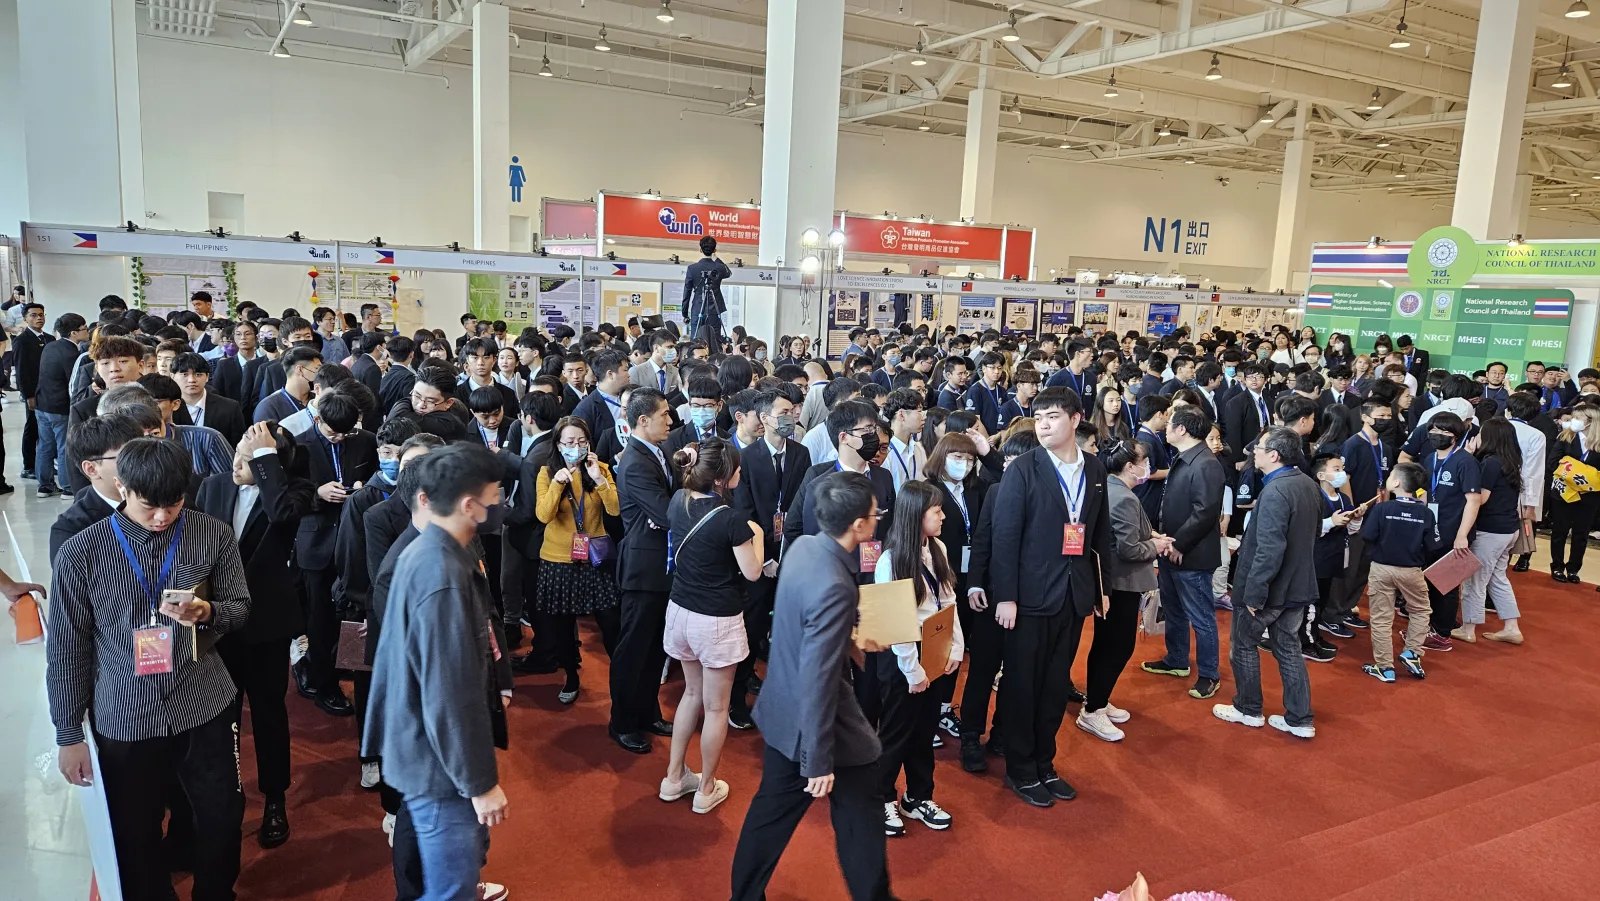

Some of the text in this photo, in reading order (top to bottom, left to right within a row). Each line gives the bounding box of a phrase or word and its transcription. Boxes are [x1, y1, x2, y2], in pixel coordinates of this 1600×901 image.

[708, 210, 739, 223] World
[902, 226, 931, 238] Taiwan
[1187, 220, 1210, 238] 出口
[1143, 216, 1182, 253] N1
[185, 243, 228, 252] PHILIPPINES
[1185, 241, 1208, 255] EXIT
[1486, 249, 1597, 257] NATIONAL RESEARCH
[462, 258, 496, 267] PHILIPPINES
[1485, 260, 1596, 268] COUNCIL OF THAILAND
[1495, 298, 1528, 306] Research
[1490, 307, 1499, 315] of
[1500, 308, 1531, 316] Thailand
[1423, 333, 1452, 342] NRCT
[1457, 335, 1486, 344] MHESI
[1492, 337, 1525, 346] NRCT
[1531, 339, 1562, 349] MHESI
[617, 424, 623, 434] I
